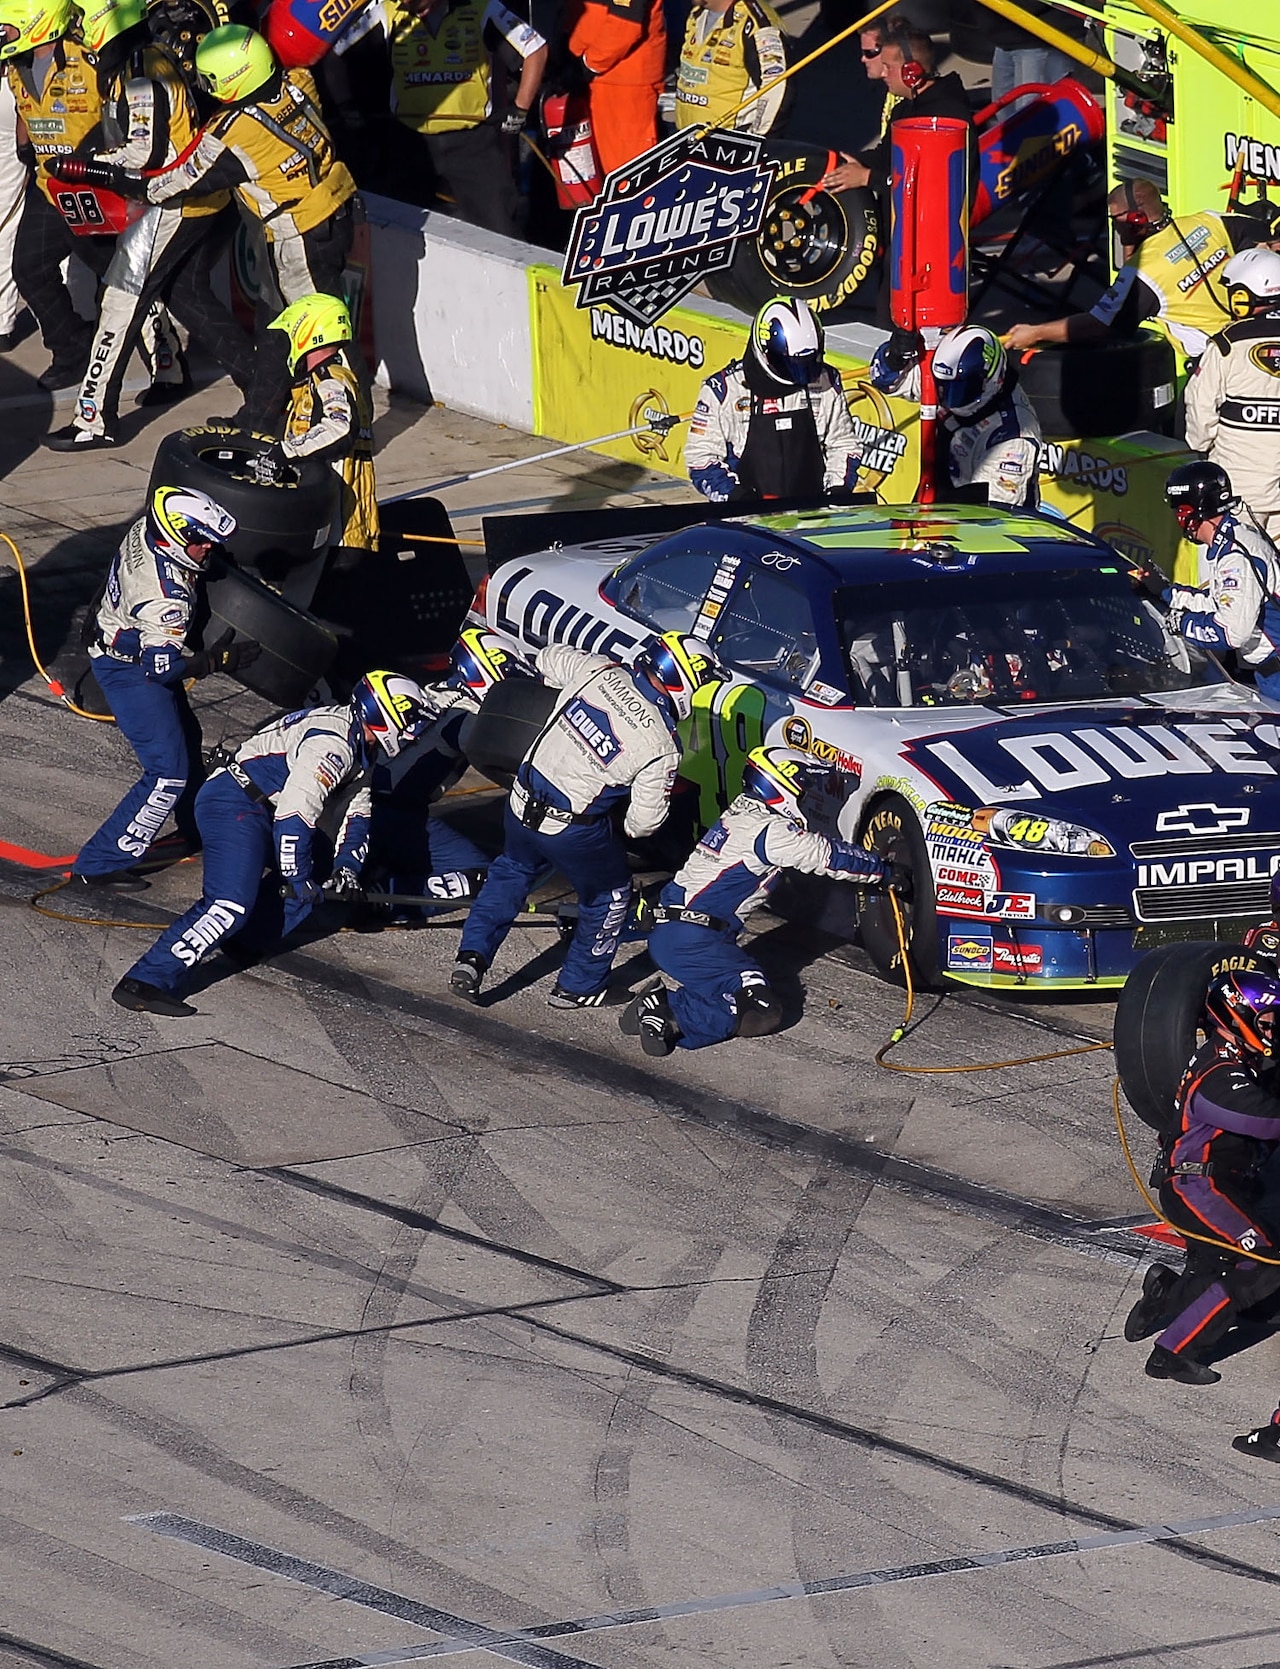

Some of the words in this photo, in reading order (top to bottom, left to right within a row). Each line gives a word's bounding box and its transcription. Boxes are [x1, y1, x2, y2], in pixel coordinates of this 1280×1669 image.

[631, 140, 736, 188] TEAM
[58, 191, 104, 226] 98
[600, 185, 746, 257] LOWE'S
[594, 246, 726, 291] RACING
[591, 308, 704, 367] MENARDS
[82, 330, 116, 399] MOEN
[1036, 442, 1128, 495] ENARDS
[168, 511, 188, 531] 48
[132, 522, 145, 569] BROWN
[485, 647, 507, 666] 48
[689, 653, 707, 673] 48
[390, 693, 413, 714] 48
[596, 684, 638, 731] lowesracing.com
[602, 671, 656, 730] SIMMONS
[565, 699, 617, 758] LOWE'S
[778, 759, 800, 778] 48
[876, 774, 927, 812] GOODYEAR
[117, 776, 188, 858] LOWE'S
[929, 823, 985, 843] MOOG
[1008, 819, 1049, 843] 48
[278, 833, 300, 878] LOWE'S
[932, 844, 990, 868] MAHLE
[938, 867, 979, 883] COMP
[937, 888, 983, 908] Edelbrock
[985, 894, 1032, 914] JE
[169, 899, 247, 968] LOWE'S
[952, 946, 989, 955] SUNOCO
[1210, 956, 1258, 978] EAGLE
